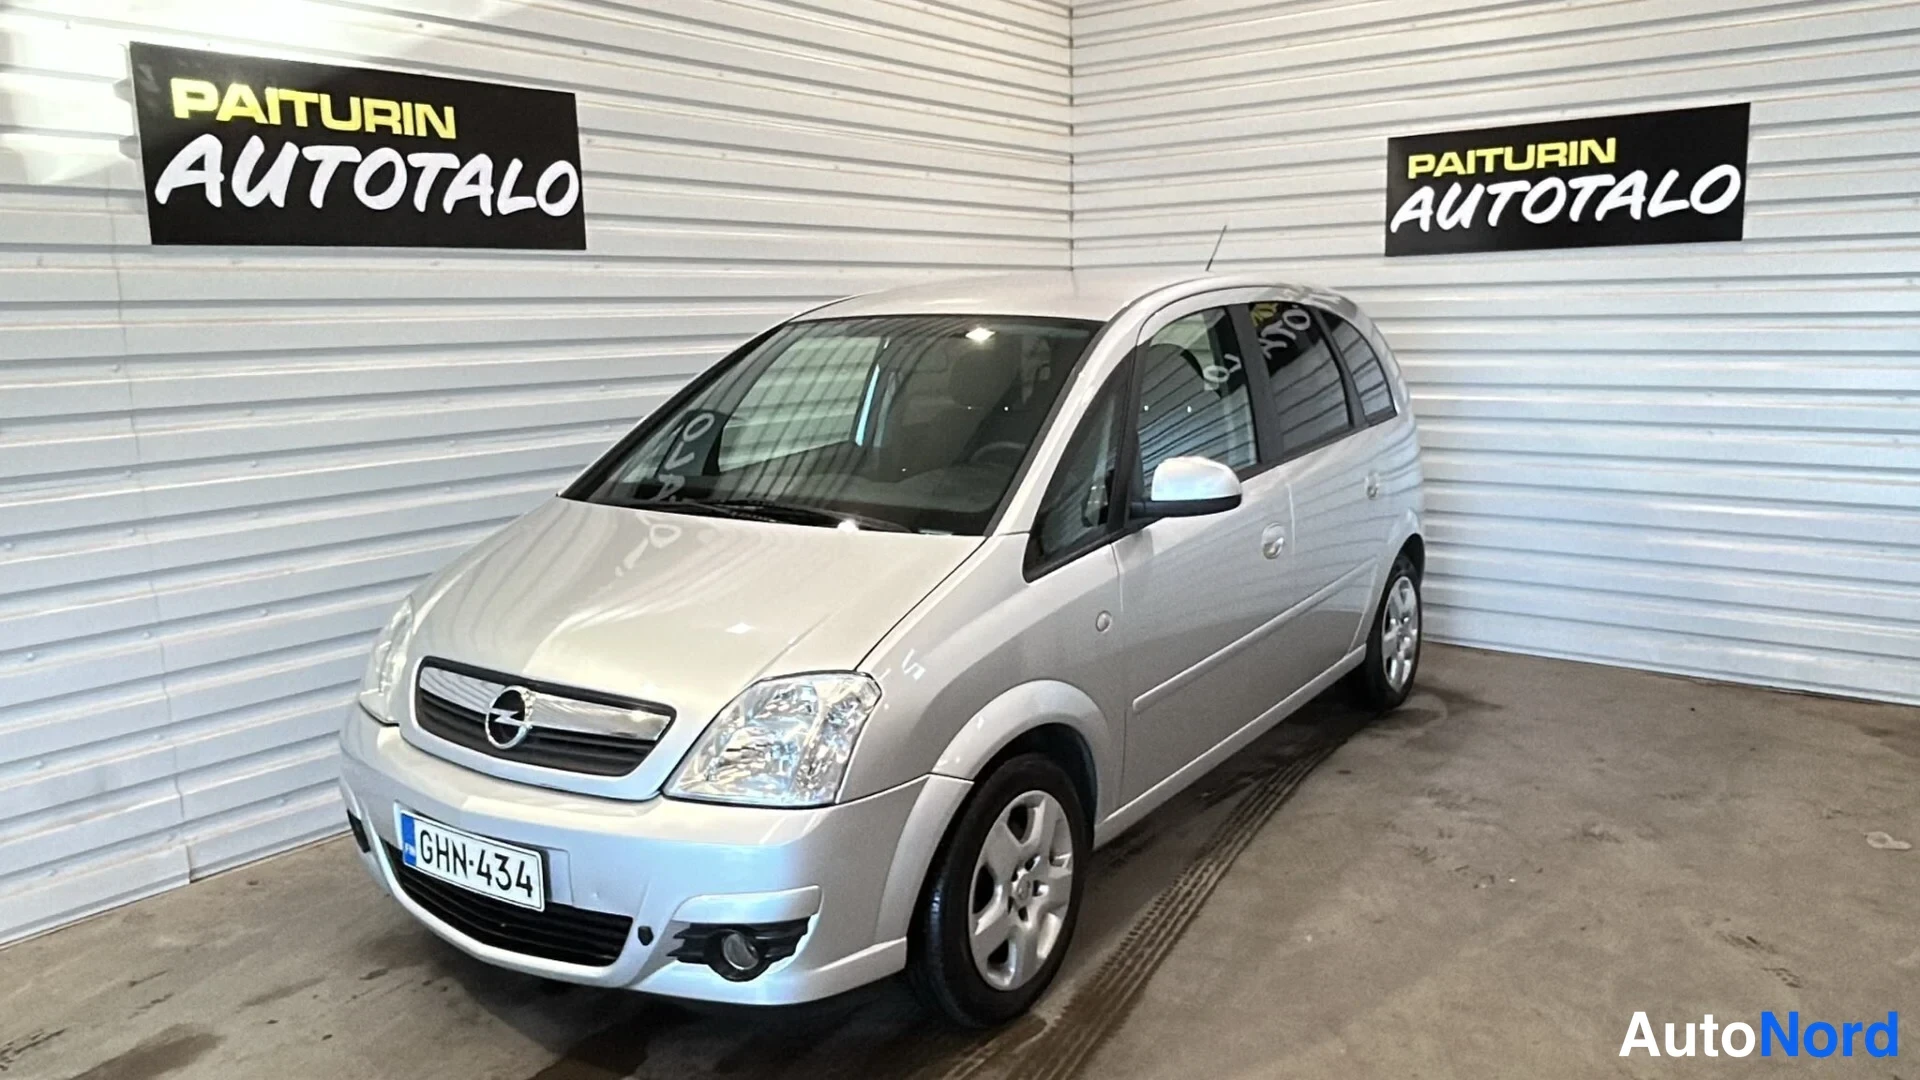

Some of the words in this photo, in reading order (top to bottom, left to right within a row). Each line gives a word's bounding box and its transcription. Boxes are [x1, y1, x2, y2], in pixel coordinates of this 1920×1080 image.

[170, 78, 457, 139] PAITURIN
[154, 133, 580, 217] AUTOTALO
[1407, 137, 1617, 179] PAITURIN
[1390, 164, 1742, 233] AUTOTALO
[420, 830, 533, 898] GHN-434
